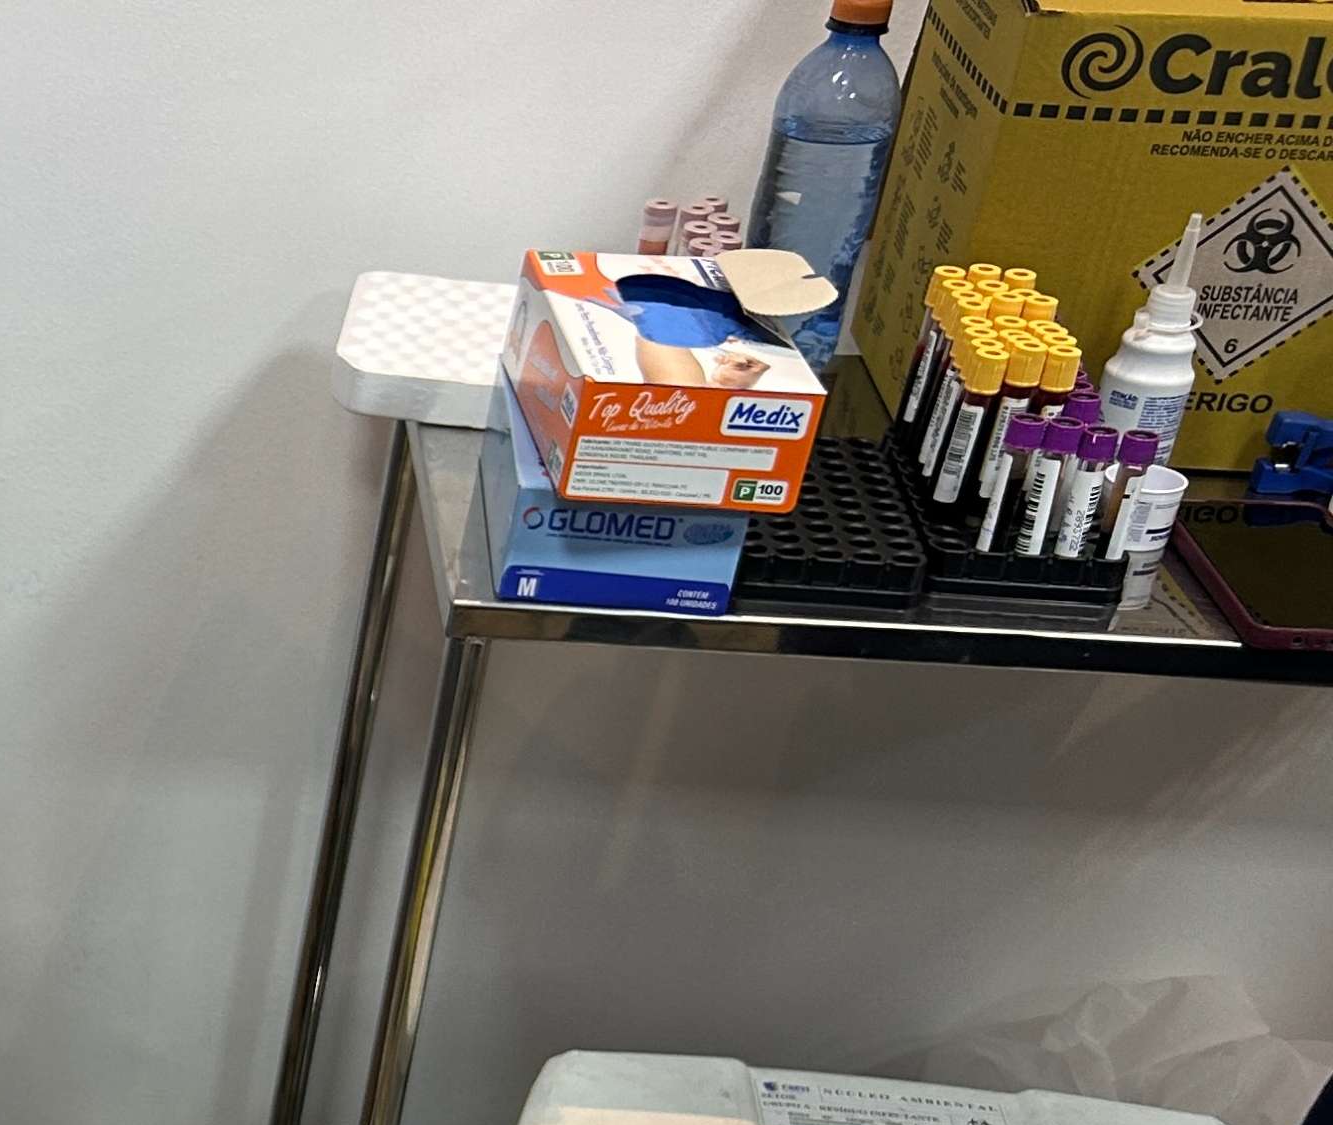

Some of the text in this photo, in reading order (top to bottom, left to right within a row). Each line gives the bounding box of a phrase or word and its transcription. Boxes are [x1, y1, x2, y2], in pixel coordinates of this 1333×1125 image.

[1149, 33, 1333, 99] Cral
[1182, 129, 1213, 144] NÃO
[1215, 132, 1273, 146] ENCHER
[1275, 133, 1320, 147] ACIMA
[1150, 143, 1262, 160] RECOMENDA-SE
[1265, 147, 1276, 161] O
[1199, 284, 1299, 305] SUBSTÂNCIA
[1196, 303, 1293, 323] INFECTANTE
[1224, 338, 1238, 354] 6
[589, 389, 697, 428] Top Quality
[1185, 392, 1274, 413] ERIGO
[729, 402, 804, 427] Medix
[739, 486, 751, 498] P
[758, 484, 784, 496] 100
[548, 508, 676, 541] GLOMED
[516, 577, 538, 598] M
